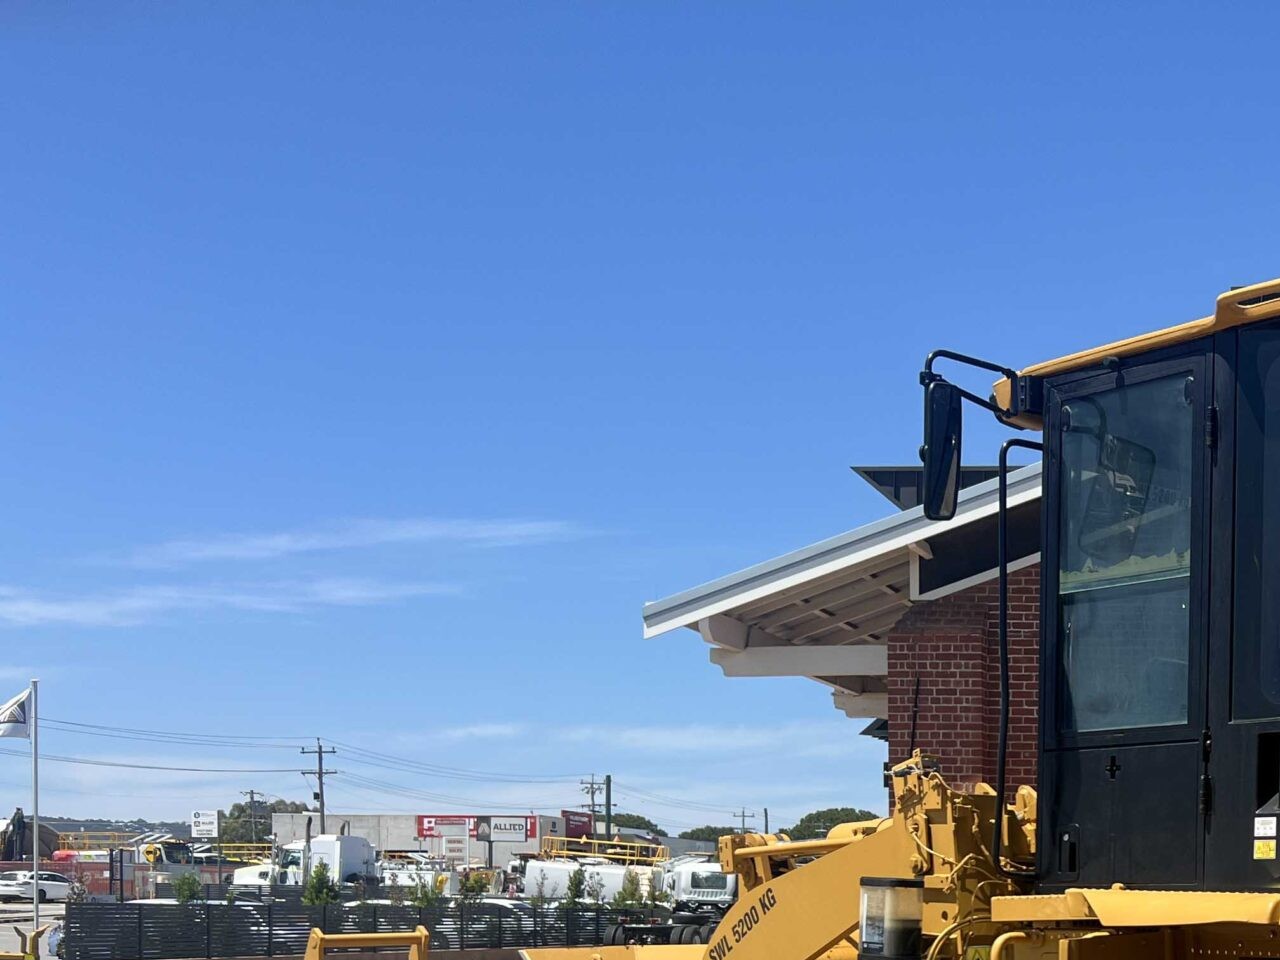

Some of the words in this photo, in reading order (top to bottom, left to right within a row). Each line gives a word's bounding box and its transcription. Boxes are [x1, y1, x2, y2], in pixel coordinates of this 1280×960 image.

[494, 823, 524, 831] ALLIED
[731, 905, 759, 943] 5200
[758, 888, 776, 915] KG
